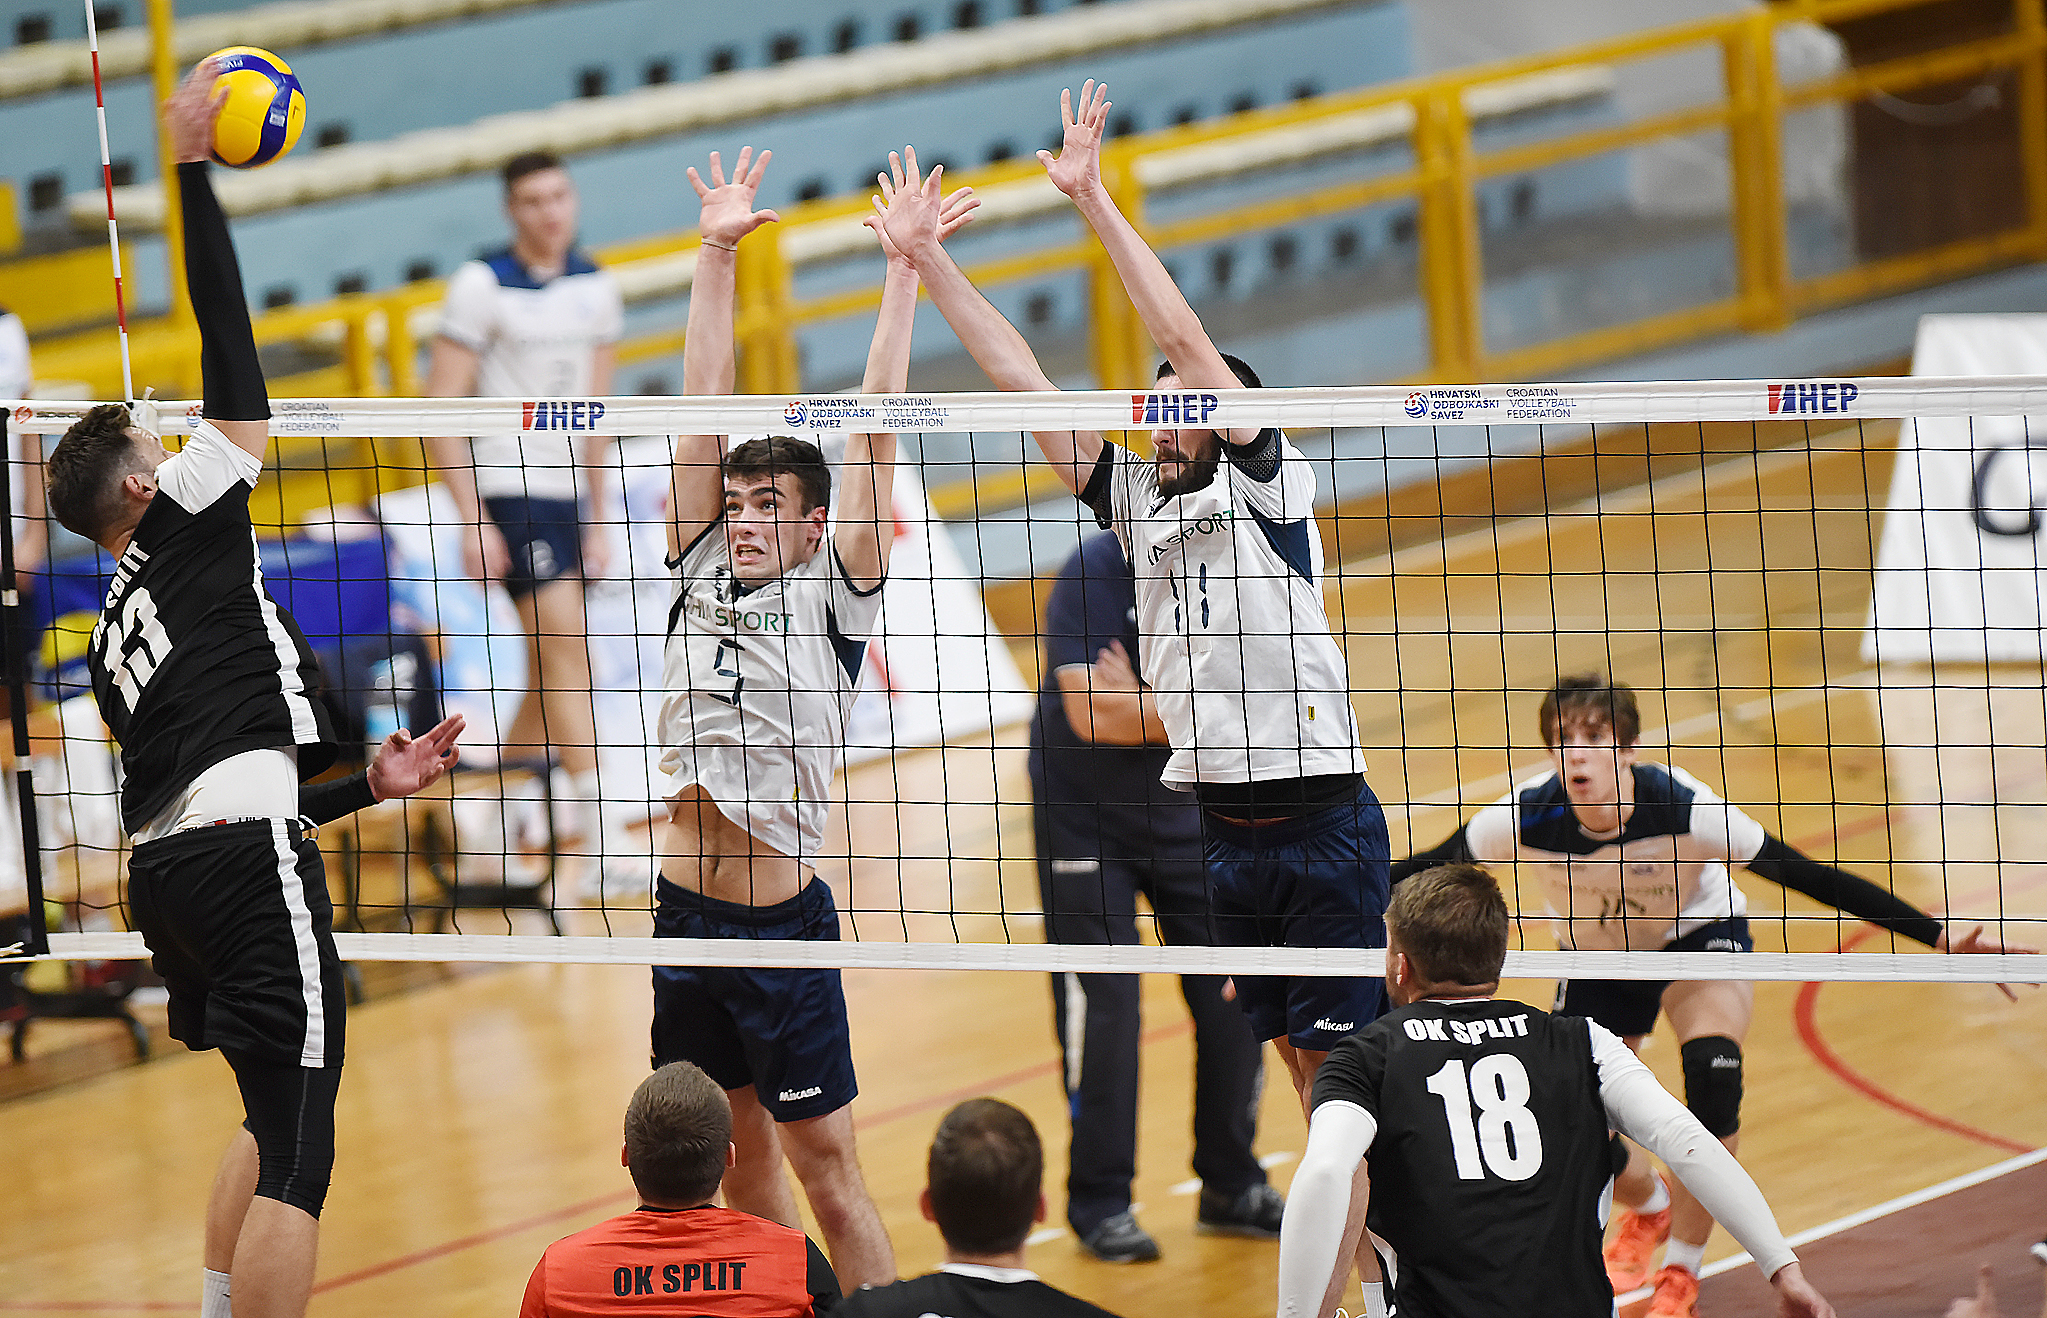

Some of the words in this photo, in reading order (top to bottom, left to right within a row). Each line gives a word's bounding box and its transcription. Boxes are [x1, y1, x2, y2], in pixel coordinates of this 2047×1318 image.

[1429, 390, 1482, 399] HRVATSKI
[1506, 388, 1558, 397] CROATIAN
[881, 398, 932, 407] CROATIAN
[1510, 398, 1577, 408] VOLLEYBALL
[1798, 383, 1859, 413] HEP
[280, 402, 329, 411] CROATIAN
[808, 399, 858, 408] HRVATSKI
[1433, 398, 1499, 409] ODBOJKAŠKI
[811, 407, 876, 418] ODBOJKAŠKI
[884, 408, 949, 417] VOLLEYBALL
[1161, 394, 1218, 424] HEP
[1506, 409, 1571, 418] FEDERATION
[284, 413, 346, 421] VOLLEYBALL
[550, 402, 606, 430] HEP
[1430, 411, 1464, 420] SAVEZ
[280, 423, 340, 432] FEDERATION
[809, 419, 842, 429] SAVEZ
[882, 418, 944, 428] FEDERATION
[103, 586, 174, 715] 13
[707, 638, 745, 706] 5
[1402, 1018, 1450, 1041] OK
[1448, 1013, 1529, 1046] SPLIT
[1426, 1053, 1543, 1181] 18
[613, 1266, 655, 1297] OK
[662, 1262, 747, 1293] SPLIT
